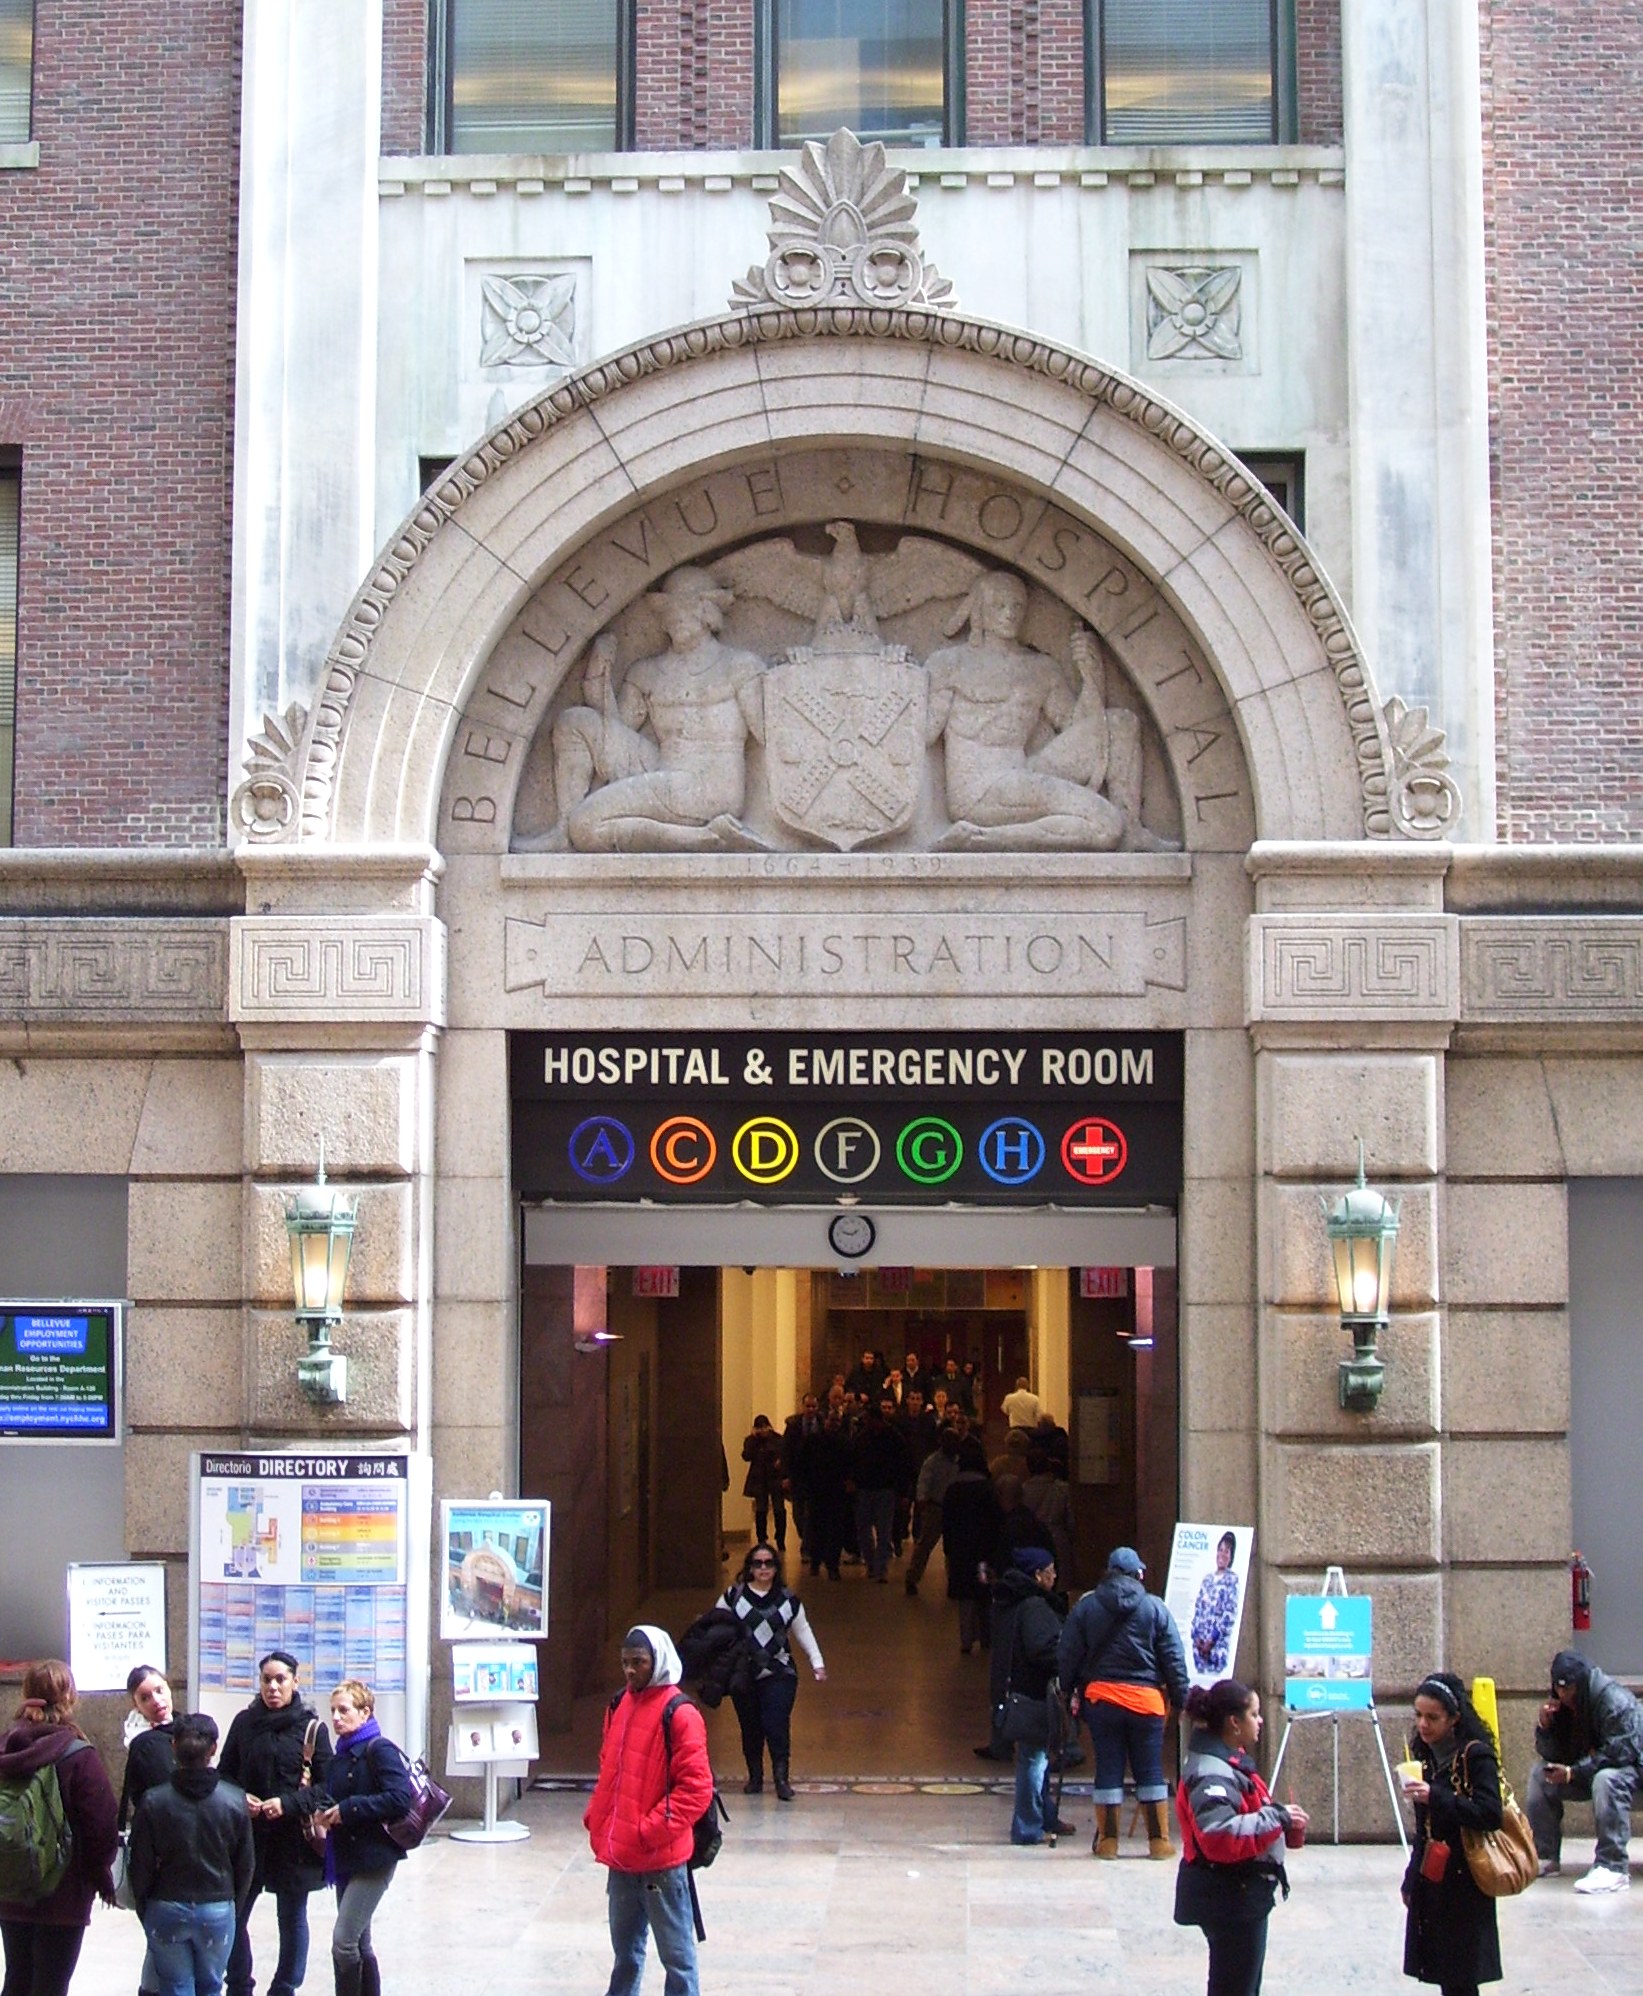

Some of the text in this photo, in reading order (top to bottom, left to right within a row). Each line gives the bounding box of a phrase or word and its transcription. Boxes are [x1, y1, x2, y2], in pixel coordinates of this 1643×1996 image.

[452, 469, 782, 825] BELLEVUE
[911, 467, 1240, 822] HOSPITAL
[577, 935, 1114, 975] ADMINISTRATION
[544, 1047, 1154, 1086] HOSPITAL & EMERGENCY ROOM
[581, 1127, 1031, 1171] A C D F G H
[1073, 1146, 1116, 1156] EMERGENCY
[639, 1267, 673, 1295] EXIT
[1086, 1268, 1120, 1295] EXIT
[32, 1319, 71, 1328] BELLEVUE
[24, 1329, 78, 1338] EMPLOYMENT
[20, 1340, 83, 1349] OPPORTUNITIES
[15, 1364, 57, 1373] Resources
[60, 1365, 106, 1374] Department
[206, 1459, 349, 1476] Directorio DIRECTORY
[1178, 1530, 1208, 1540] COLON
[1177, 1540, 1209, 1550] CANCER
[93, 1577, 146, 1585] INFORMATION
[108, 1587, 128, 1595] AND
[86, 1596, 151, 1606] VISITOR PASSES
[96, 1631, 124, 1639] PASES
[128, 1631, 151, 1639] PARA
[94, 1640, 144, 1649] VISITANTES
